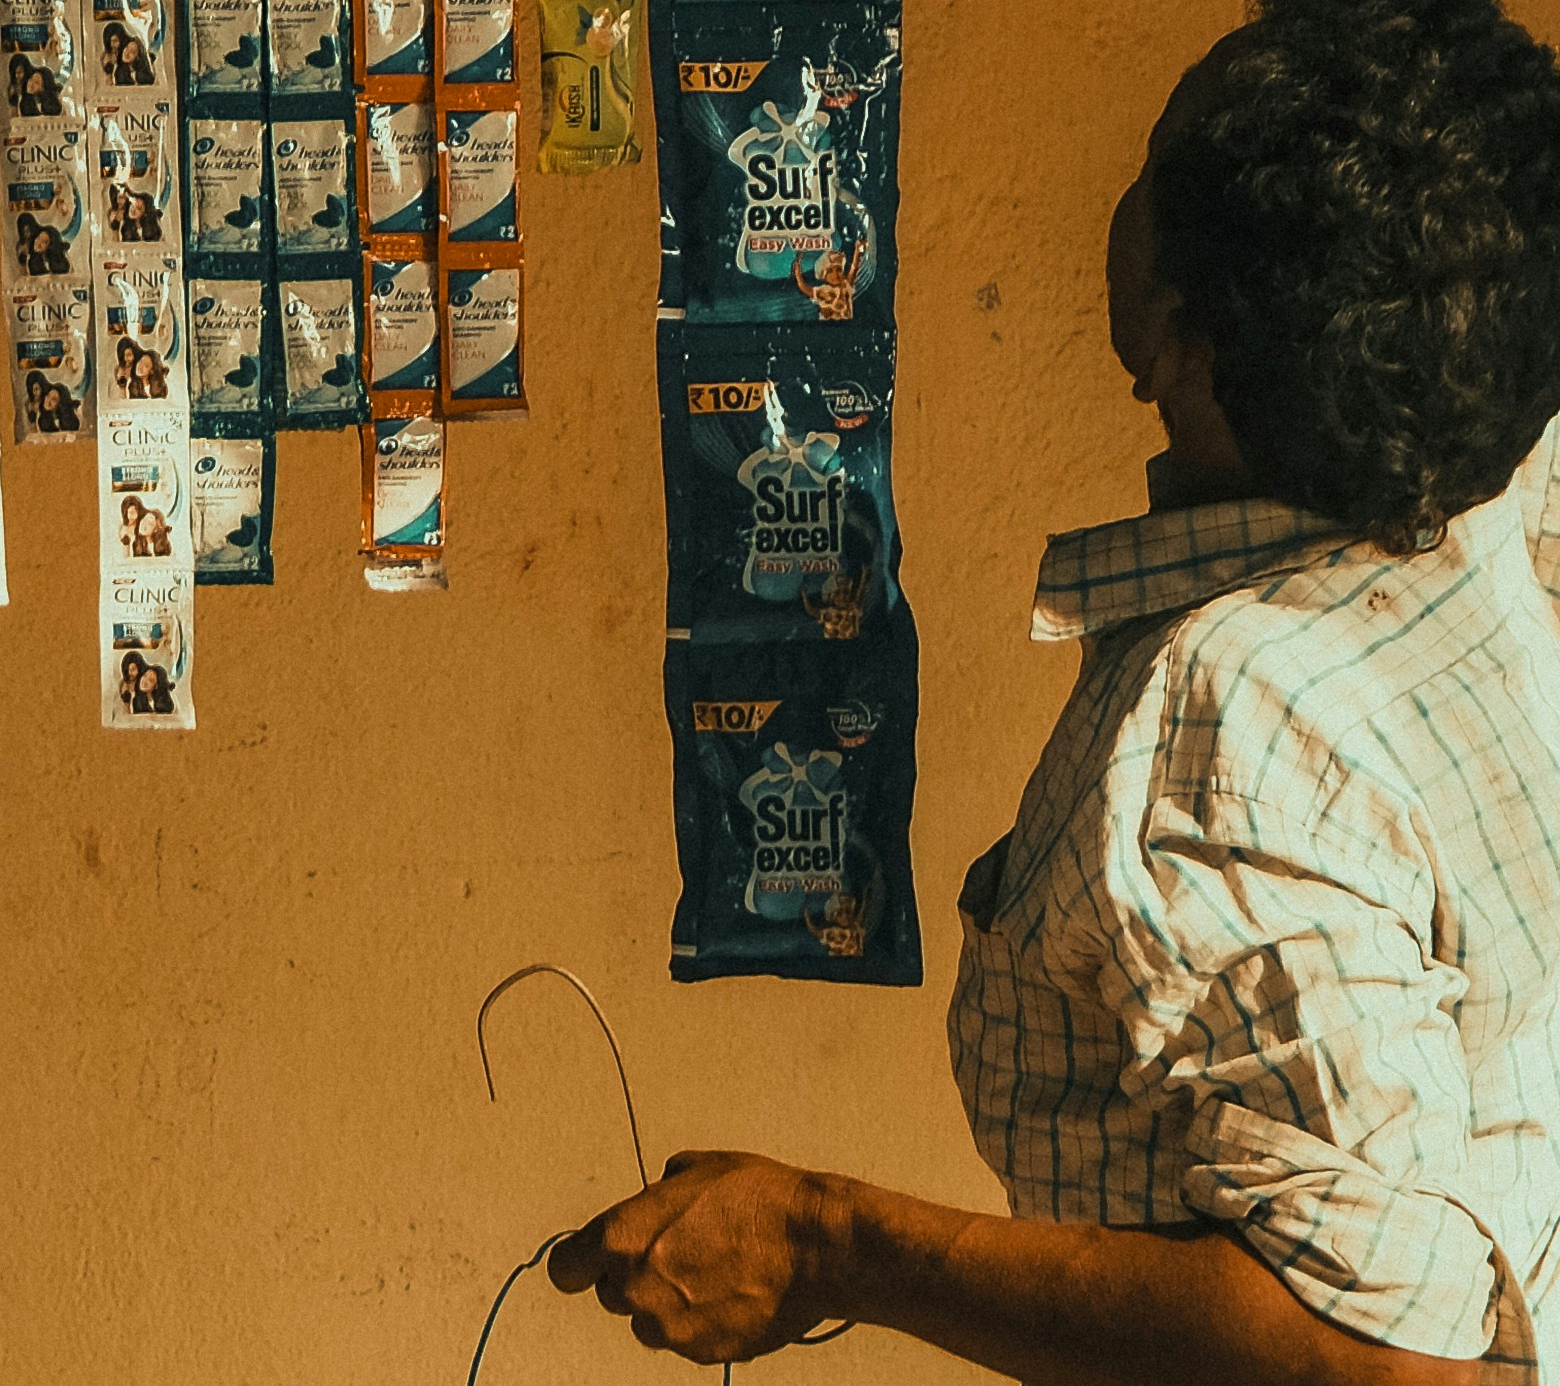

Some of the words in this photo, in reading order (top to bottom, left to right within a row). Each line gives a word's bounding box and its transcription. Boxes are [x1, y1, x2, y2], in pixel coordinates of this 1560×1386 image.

[7, 144, 74, 165] CLINIC
[451, 152, 514, 165] shoulders
[20, 166, 63, 175] PLUS+
[194, 159, 259, 172] shoulders
[748, 153, 834, 201] Surf
[748, 200, 833, 231] excel
[750, 236, 785, 251] Easy
[790, 235, 832, 250] Wash
[17, 302, 83, 322] CLINIC
[453, 311, 517, 323] shoulders
[380, 458, 441, 471] shoulders
[756, 475, 845, 524] Surf
[755, 523, 840, 554] excel
[756, 557, 791, 572] Easy
[797, 557, 839, 572] Wash
[756, 794, 845, 843] Surf
[755, 842, 843, 873] excel
